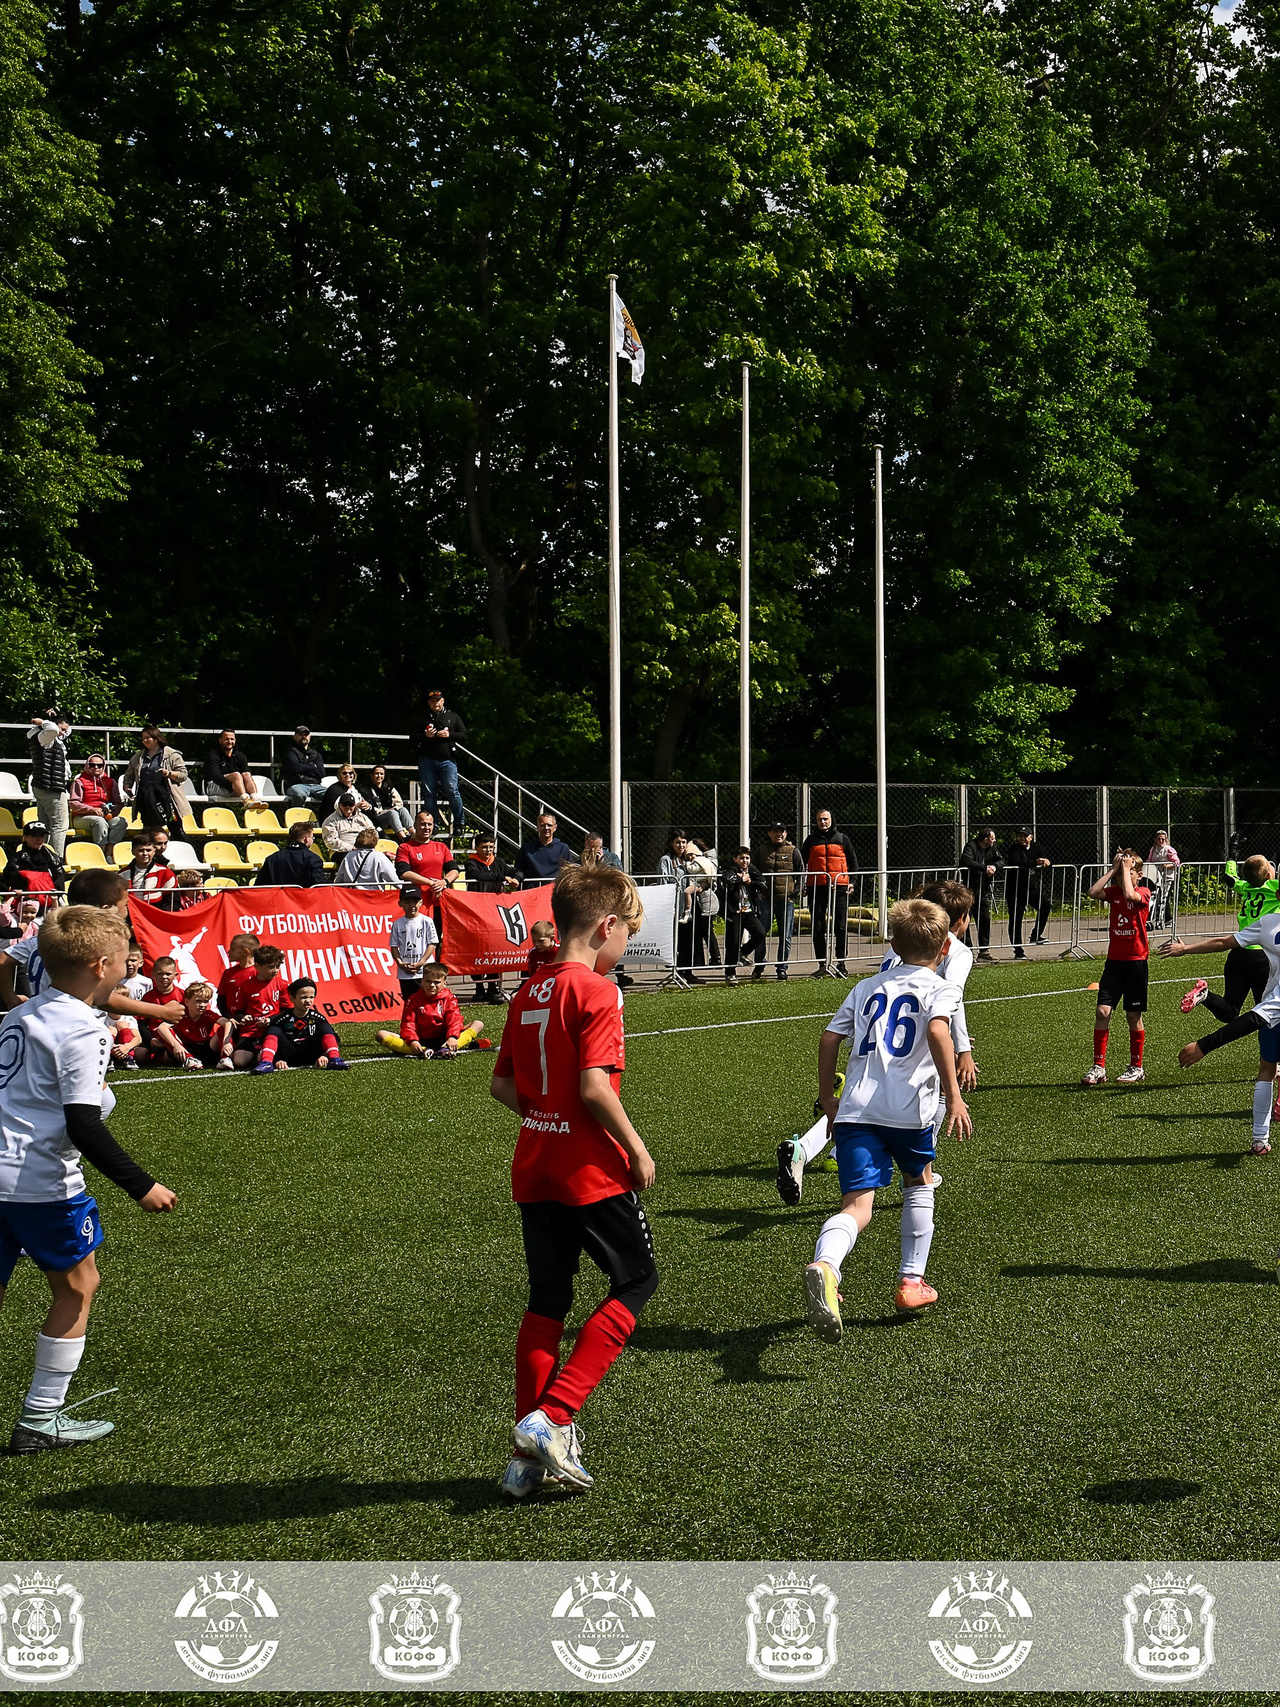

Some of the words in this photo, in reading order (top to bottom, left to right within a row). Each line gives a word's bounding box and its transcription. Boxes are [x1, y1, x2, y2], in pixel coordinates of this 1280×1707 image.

[238, 909, 353, 935] ФУТБОЛЬНЫЙ
[352, 913, 394, 934] КЛУБ
[475, 955, 529, 965] КАЛИНИН
[623, 949, 661, 957] ИНГРАД
[322, 1003, 338, 1017] В
[339, 991, 401, 1015] СВОИХ
[858, 992, 920, 1058] 26
[521, 1008, 551, 1095] 7
[81, 1215, 94, 1245] 9
